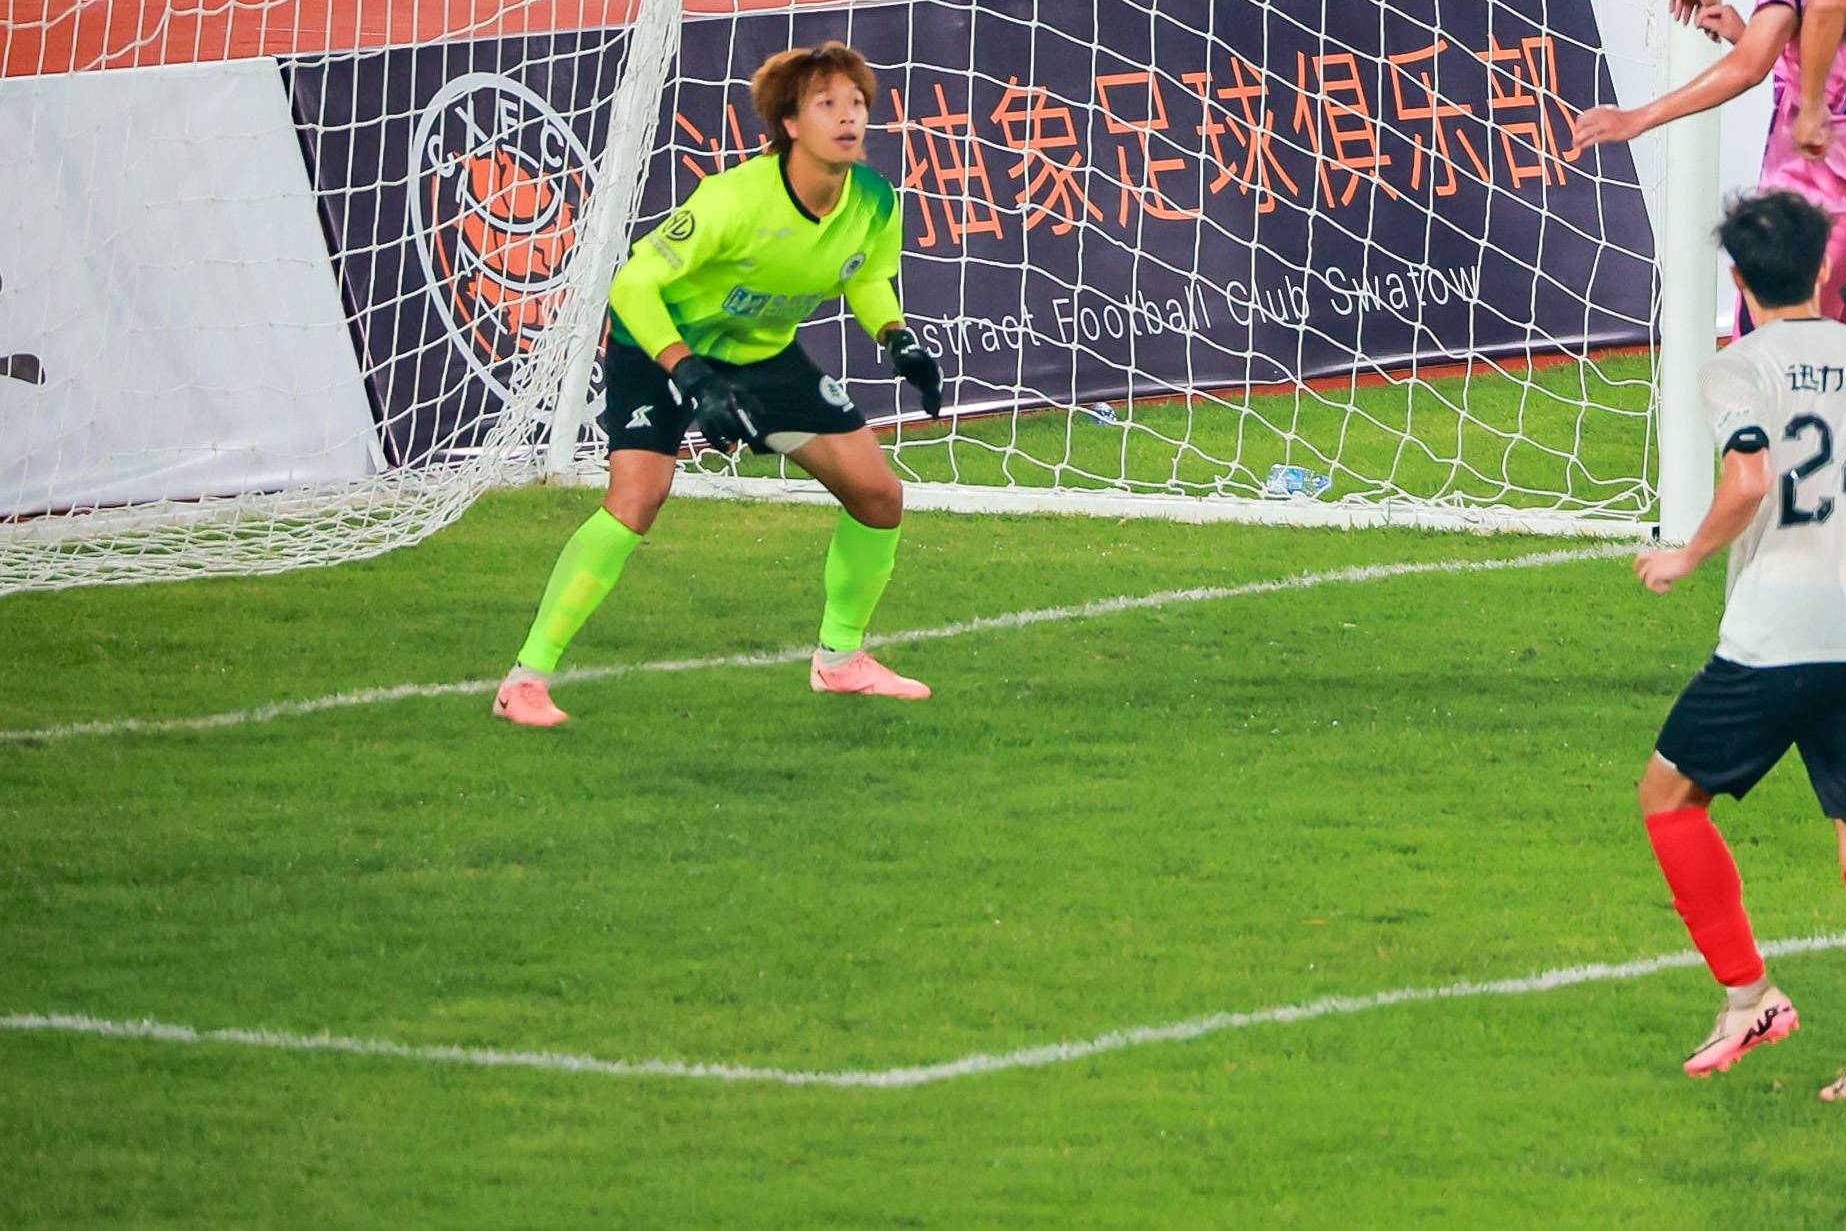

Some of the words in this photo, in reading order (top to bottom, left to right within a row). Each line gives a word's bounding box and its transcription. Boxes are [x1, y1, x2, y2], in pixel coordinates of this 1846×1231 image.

[675, 34, 1583, 249] 抽象足球俱乐部
[876, 304, 1041, 364] stract
[1051, 282, 1212, 343] Football
[1226, 275, 1309, 326] Club
[1325, 261, 1480, 316] Swatow
